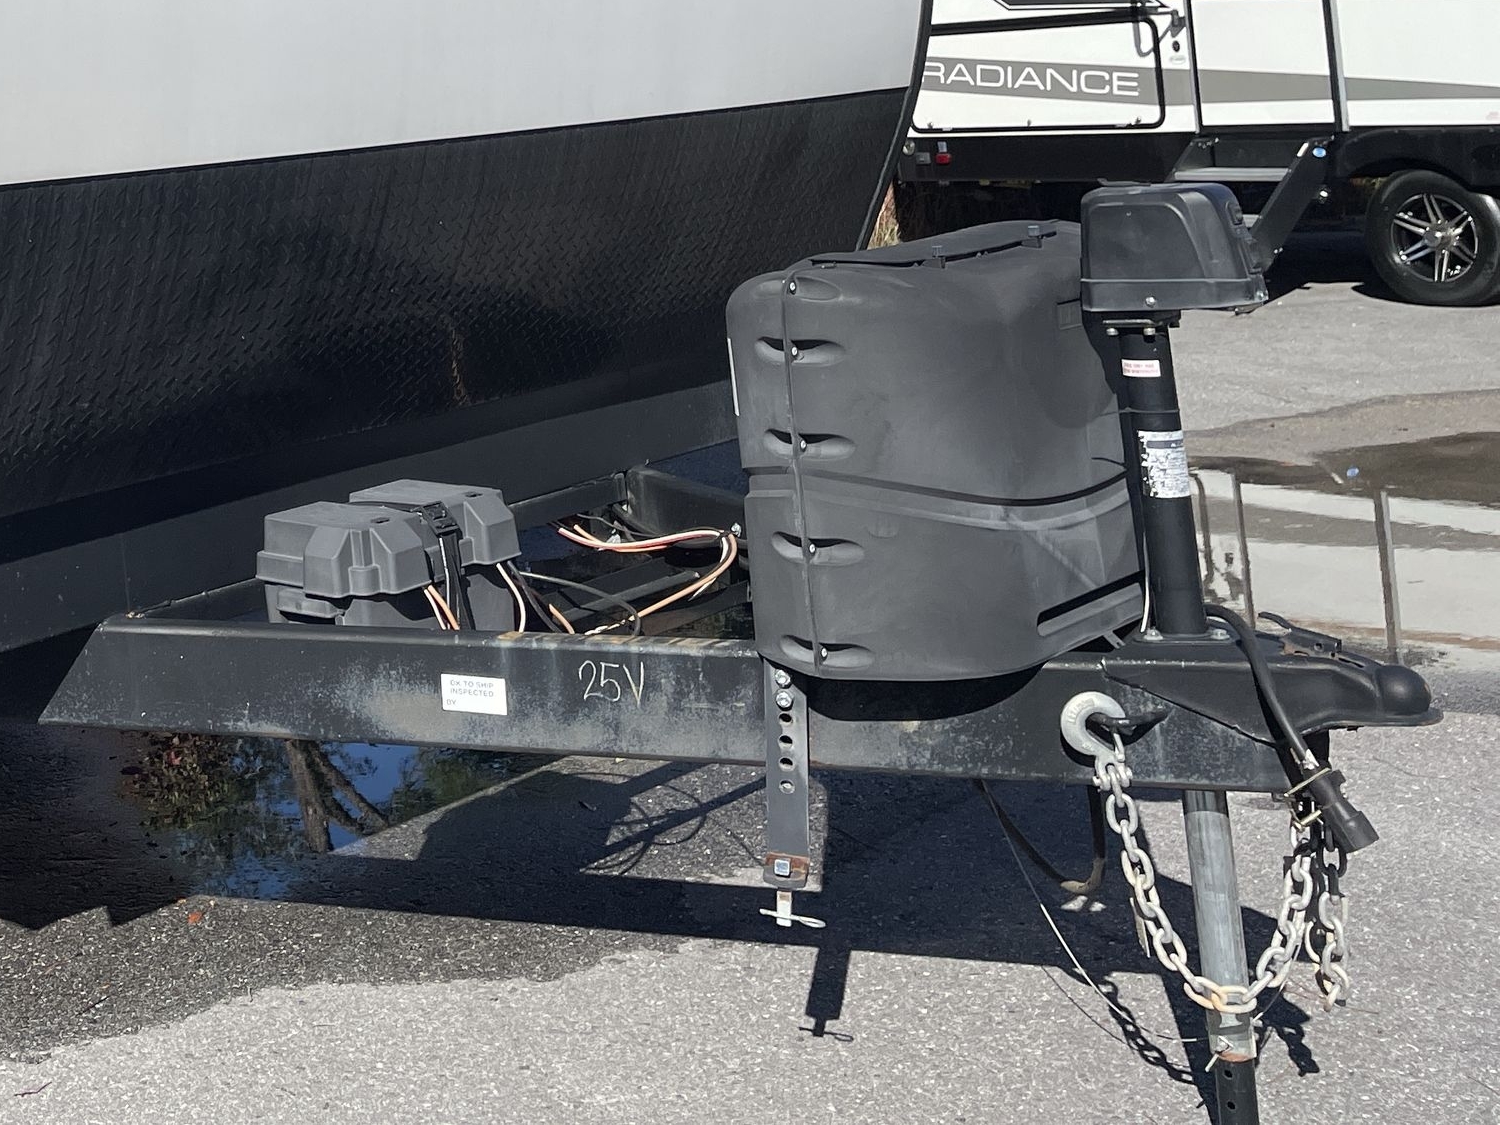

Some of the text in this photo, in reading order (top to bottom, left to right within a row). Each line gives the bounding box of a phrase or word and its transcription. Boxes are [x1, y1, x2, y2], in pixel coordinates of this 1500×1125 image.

[922, 61, 1140, 96] RADIANCE
[450, 688, 494, 698] INSPECTED
[463, 680, 474, 688] TO
[578, 660, 645, 708] 25V
